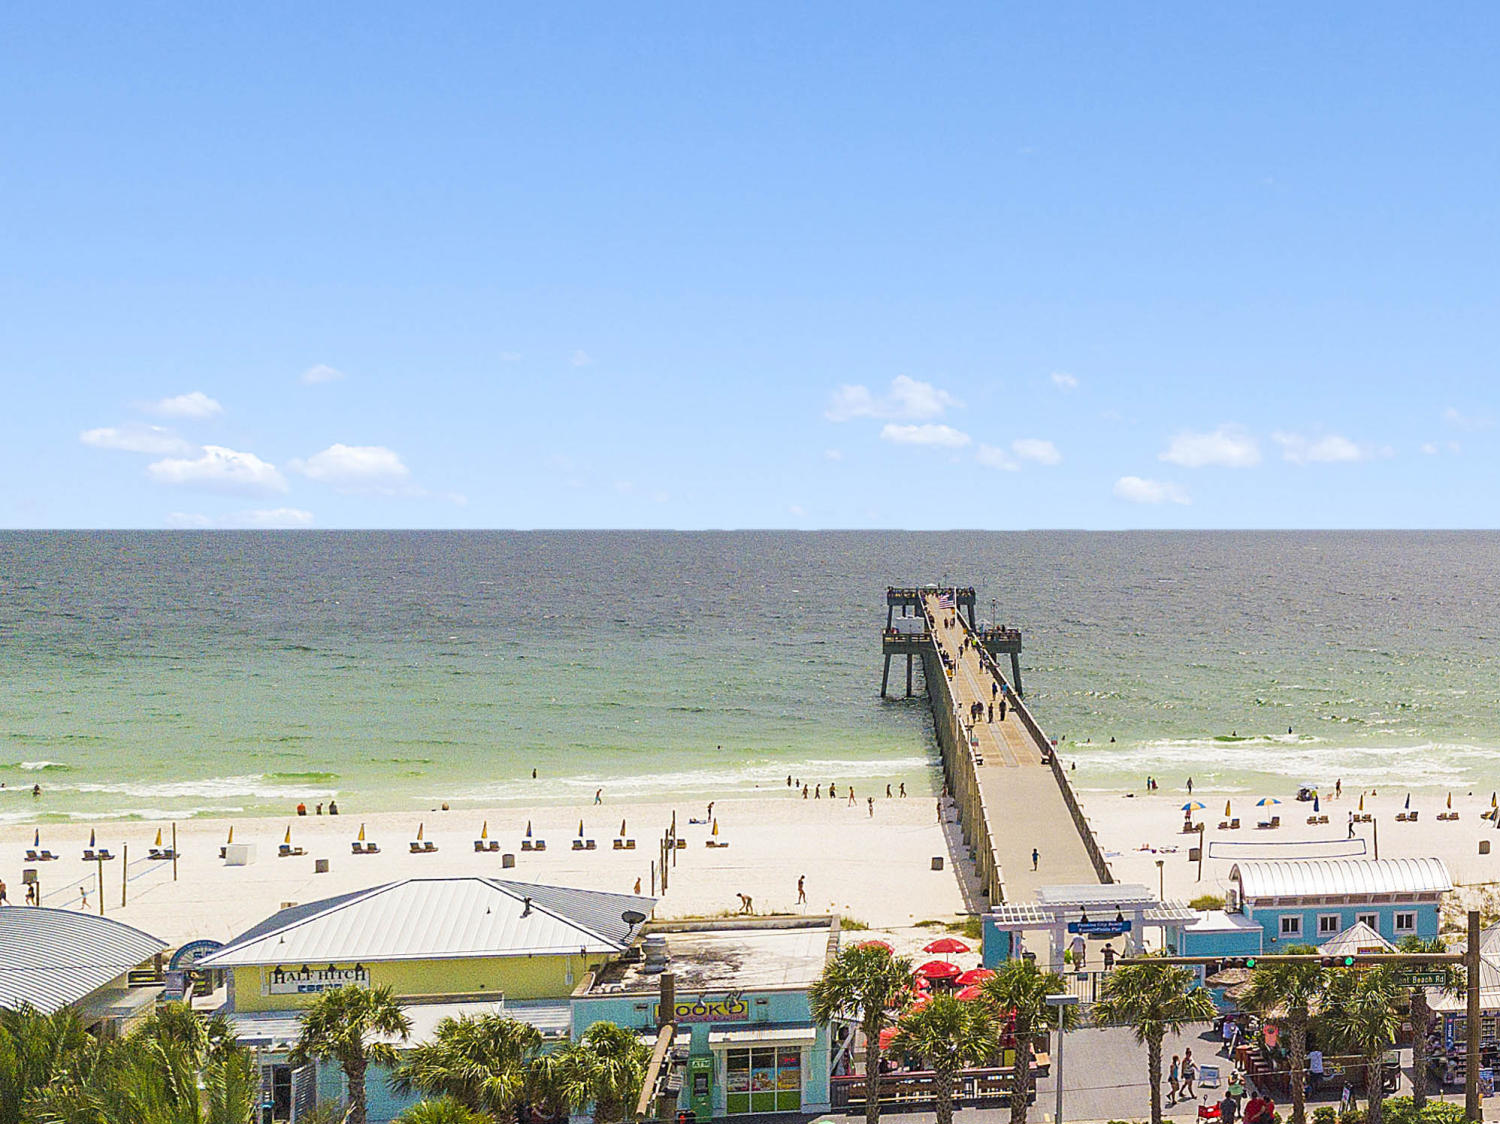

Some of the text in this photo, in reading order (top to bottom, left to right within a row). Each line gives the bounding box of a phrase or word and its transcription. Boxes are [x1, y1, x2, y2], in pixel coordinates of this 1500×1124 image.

[274, 969, 366, 984] HALF HITCH
[1412, 975, 1433, 984] Beach
[1435, 975, 1444, 983] Rd
